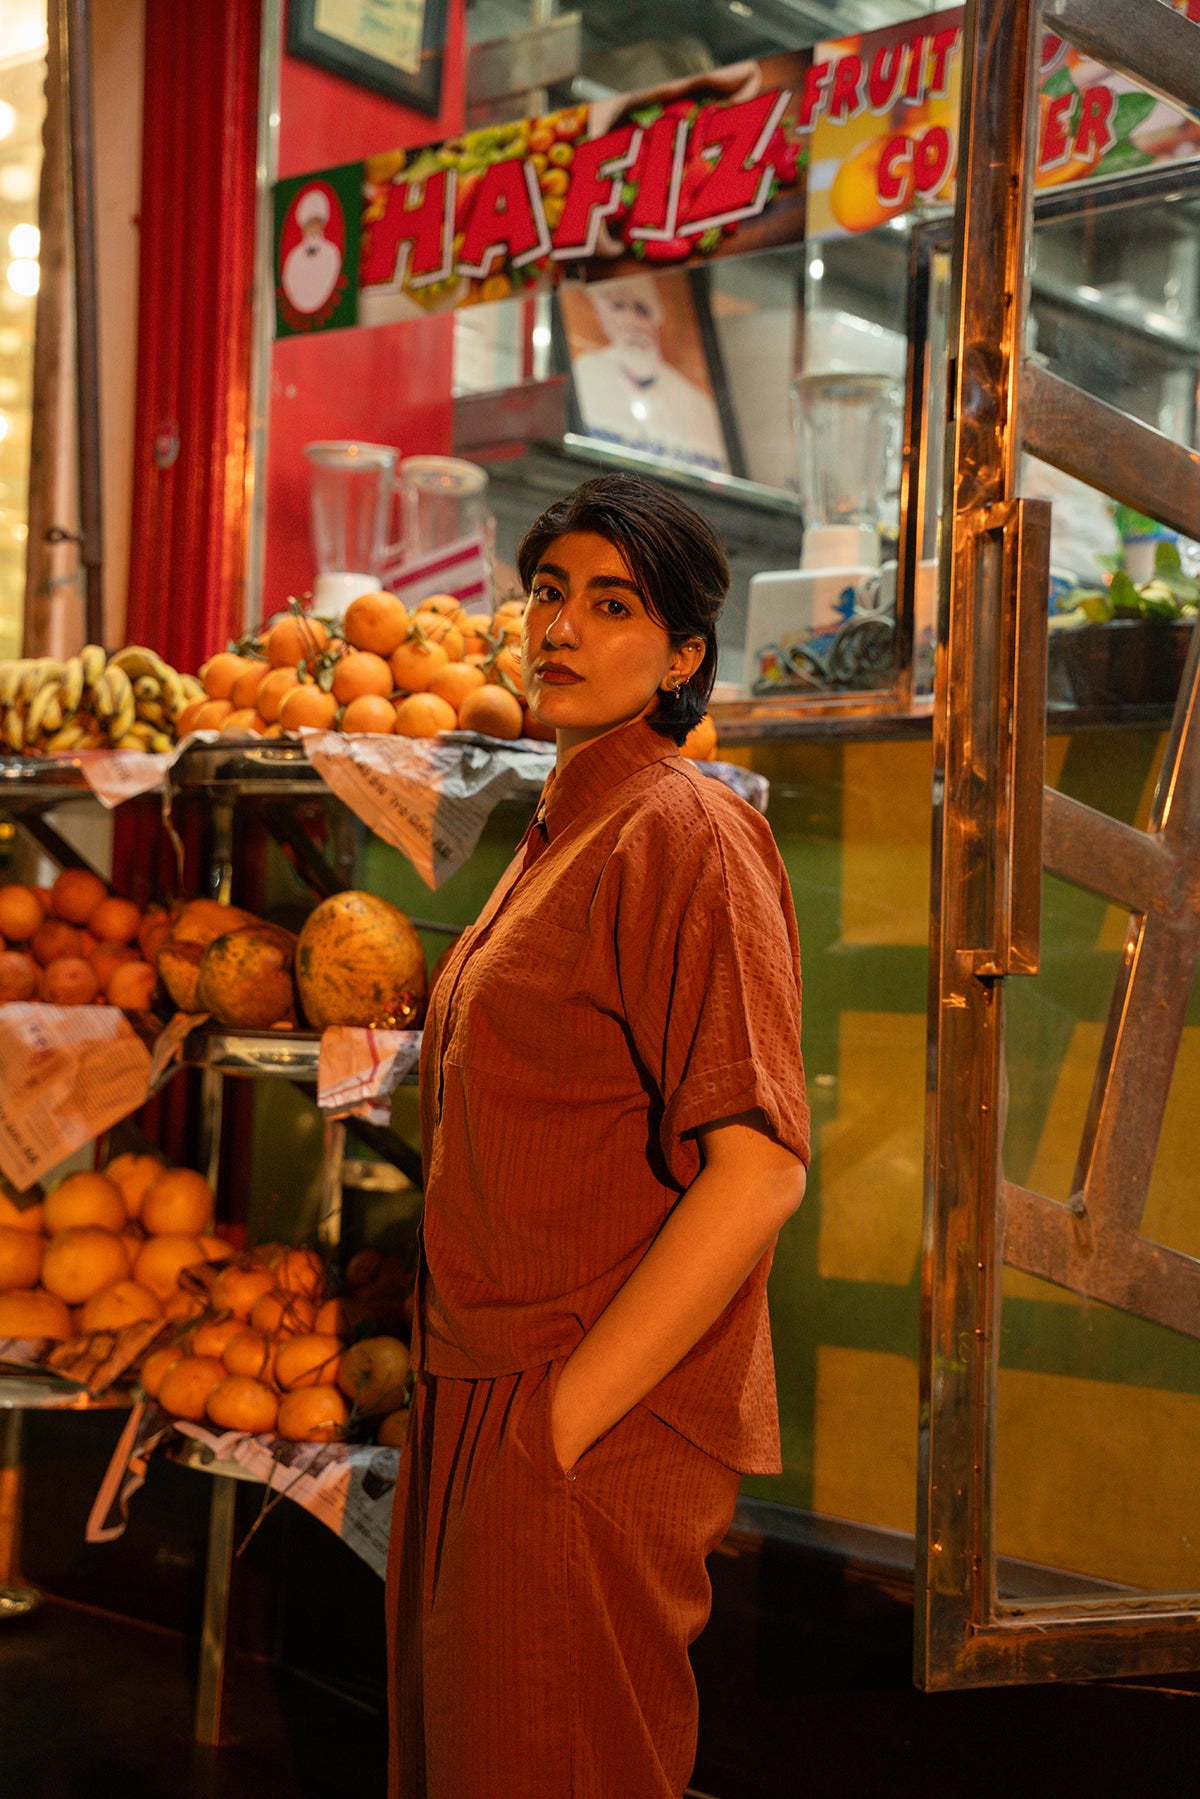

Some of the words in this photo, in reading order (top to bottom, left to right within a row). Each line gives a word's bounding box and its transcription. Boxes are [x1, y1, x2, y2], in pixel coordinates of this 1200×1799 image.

[796, 27, 963, 134] FRUIT
[361, 90, 793, 295] HAFIZ
[878, 86, 1118, 207] COER
